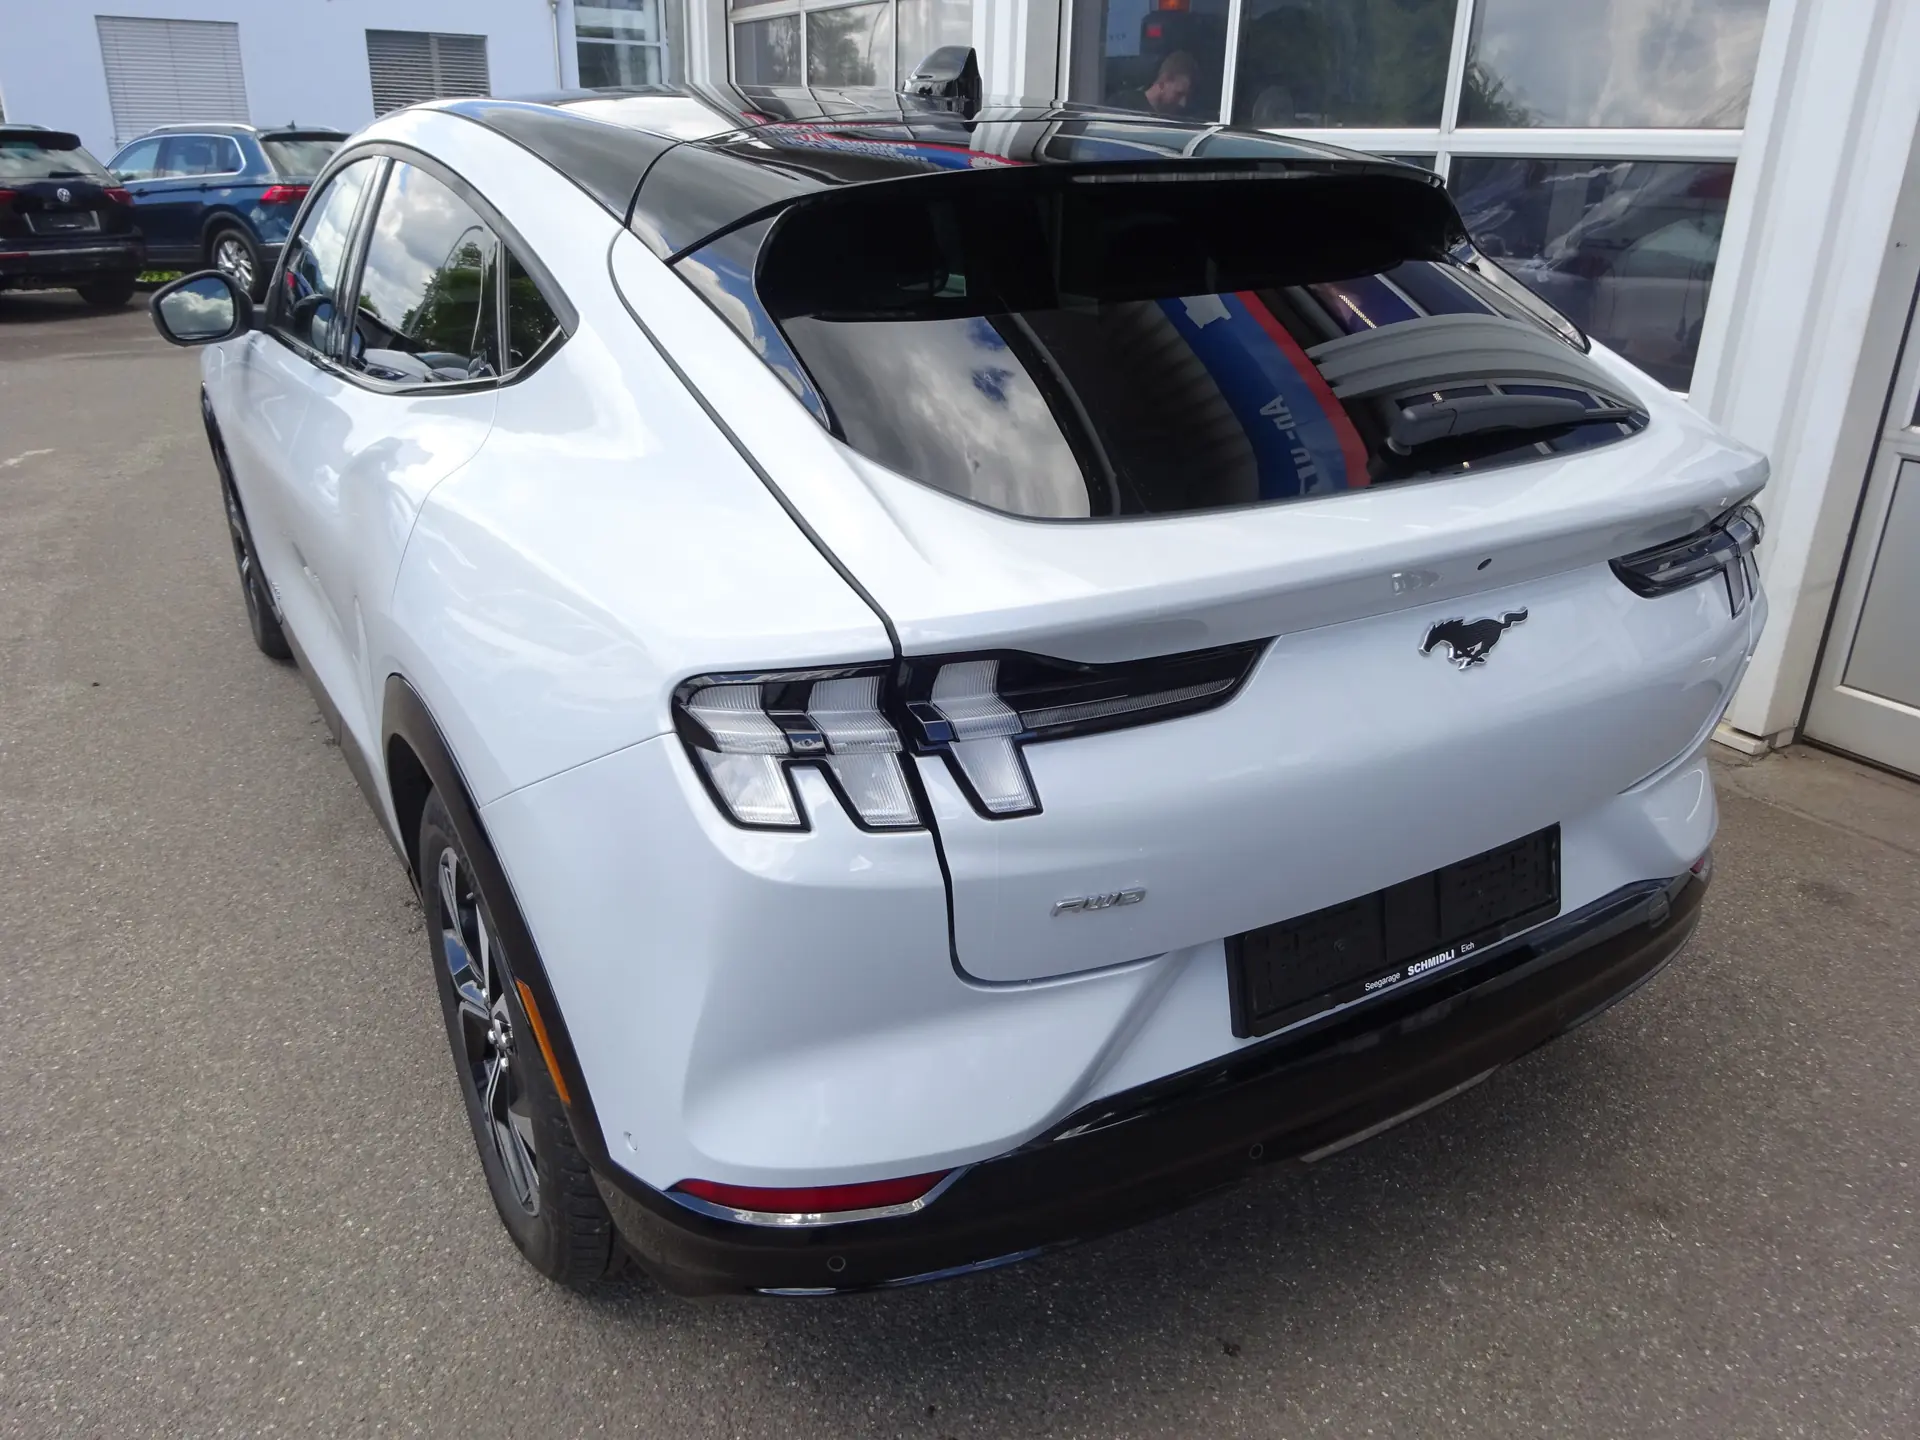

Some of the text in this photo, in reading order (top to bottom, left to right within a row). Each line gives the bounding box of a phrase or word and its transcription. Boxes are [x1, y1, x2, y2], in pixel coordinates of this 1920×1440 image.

[1364, 941, 1475, 991] Seegarage SCHMIDLI Eich
